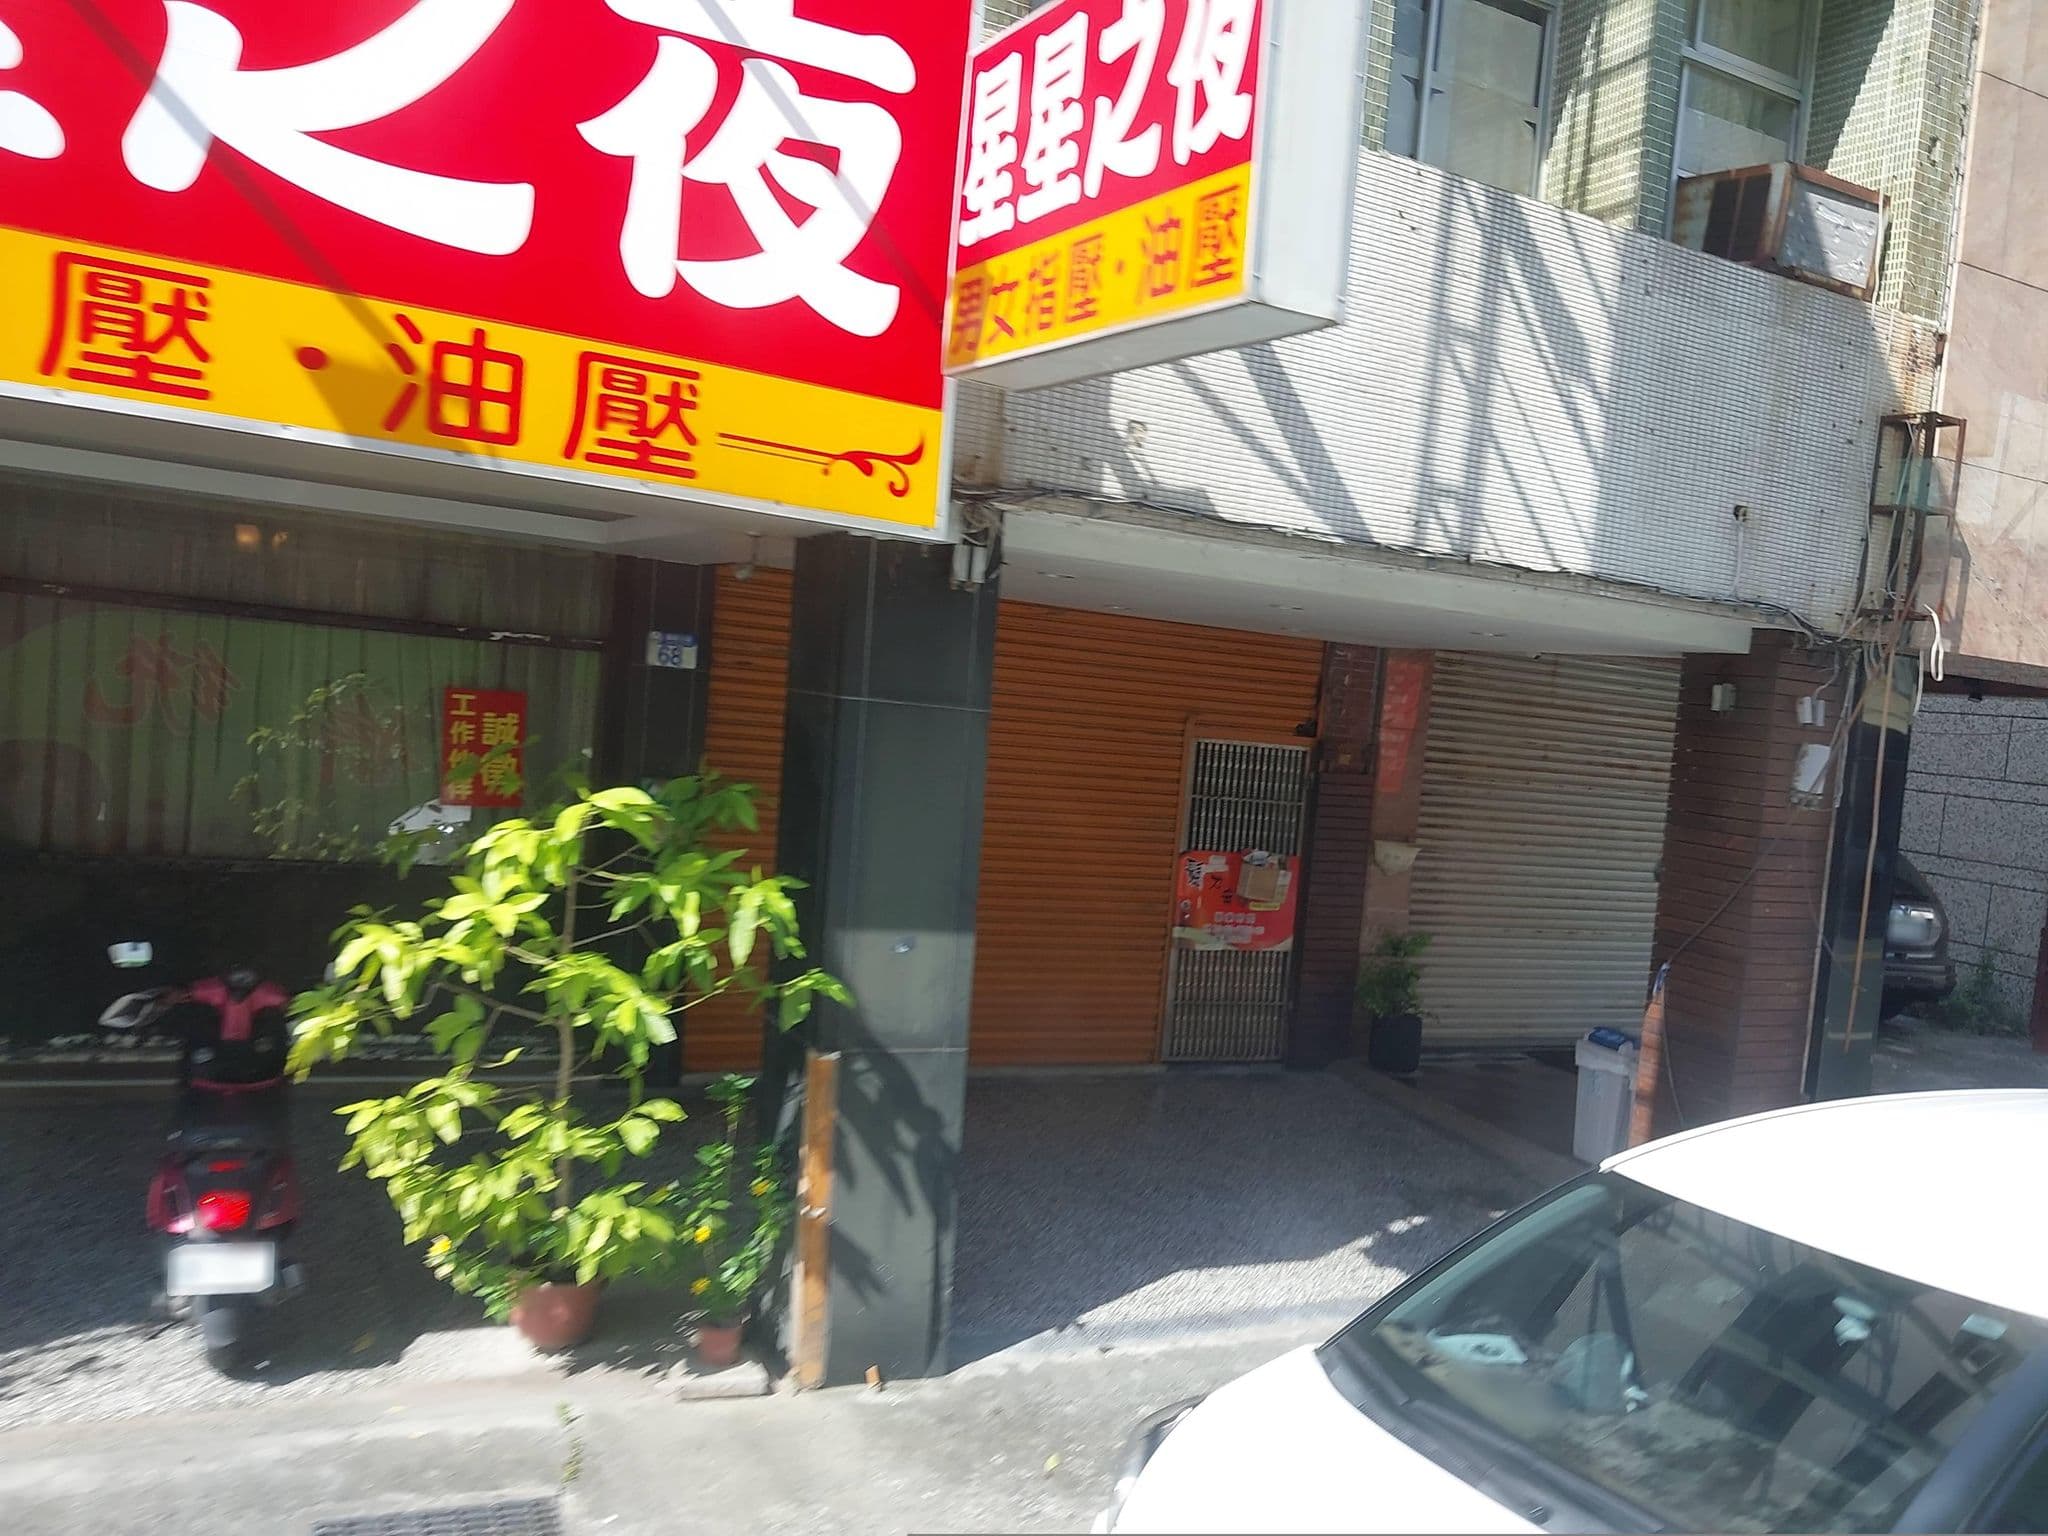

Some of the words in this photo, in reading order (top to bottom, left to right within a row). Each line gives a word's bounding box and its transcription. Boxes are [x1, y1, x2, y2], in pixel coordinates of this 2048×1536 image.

[958, 0, 1253, 246] 星星之夜
[658, 645, 682, 667] 68
